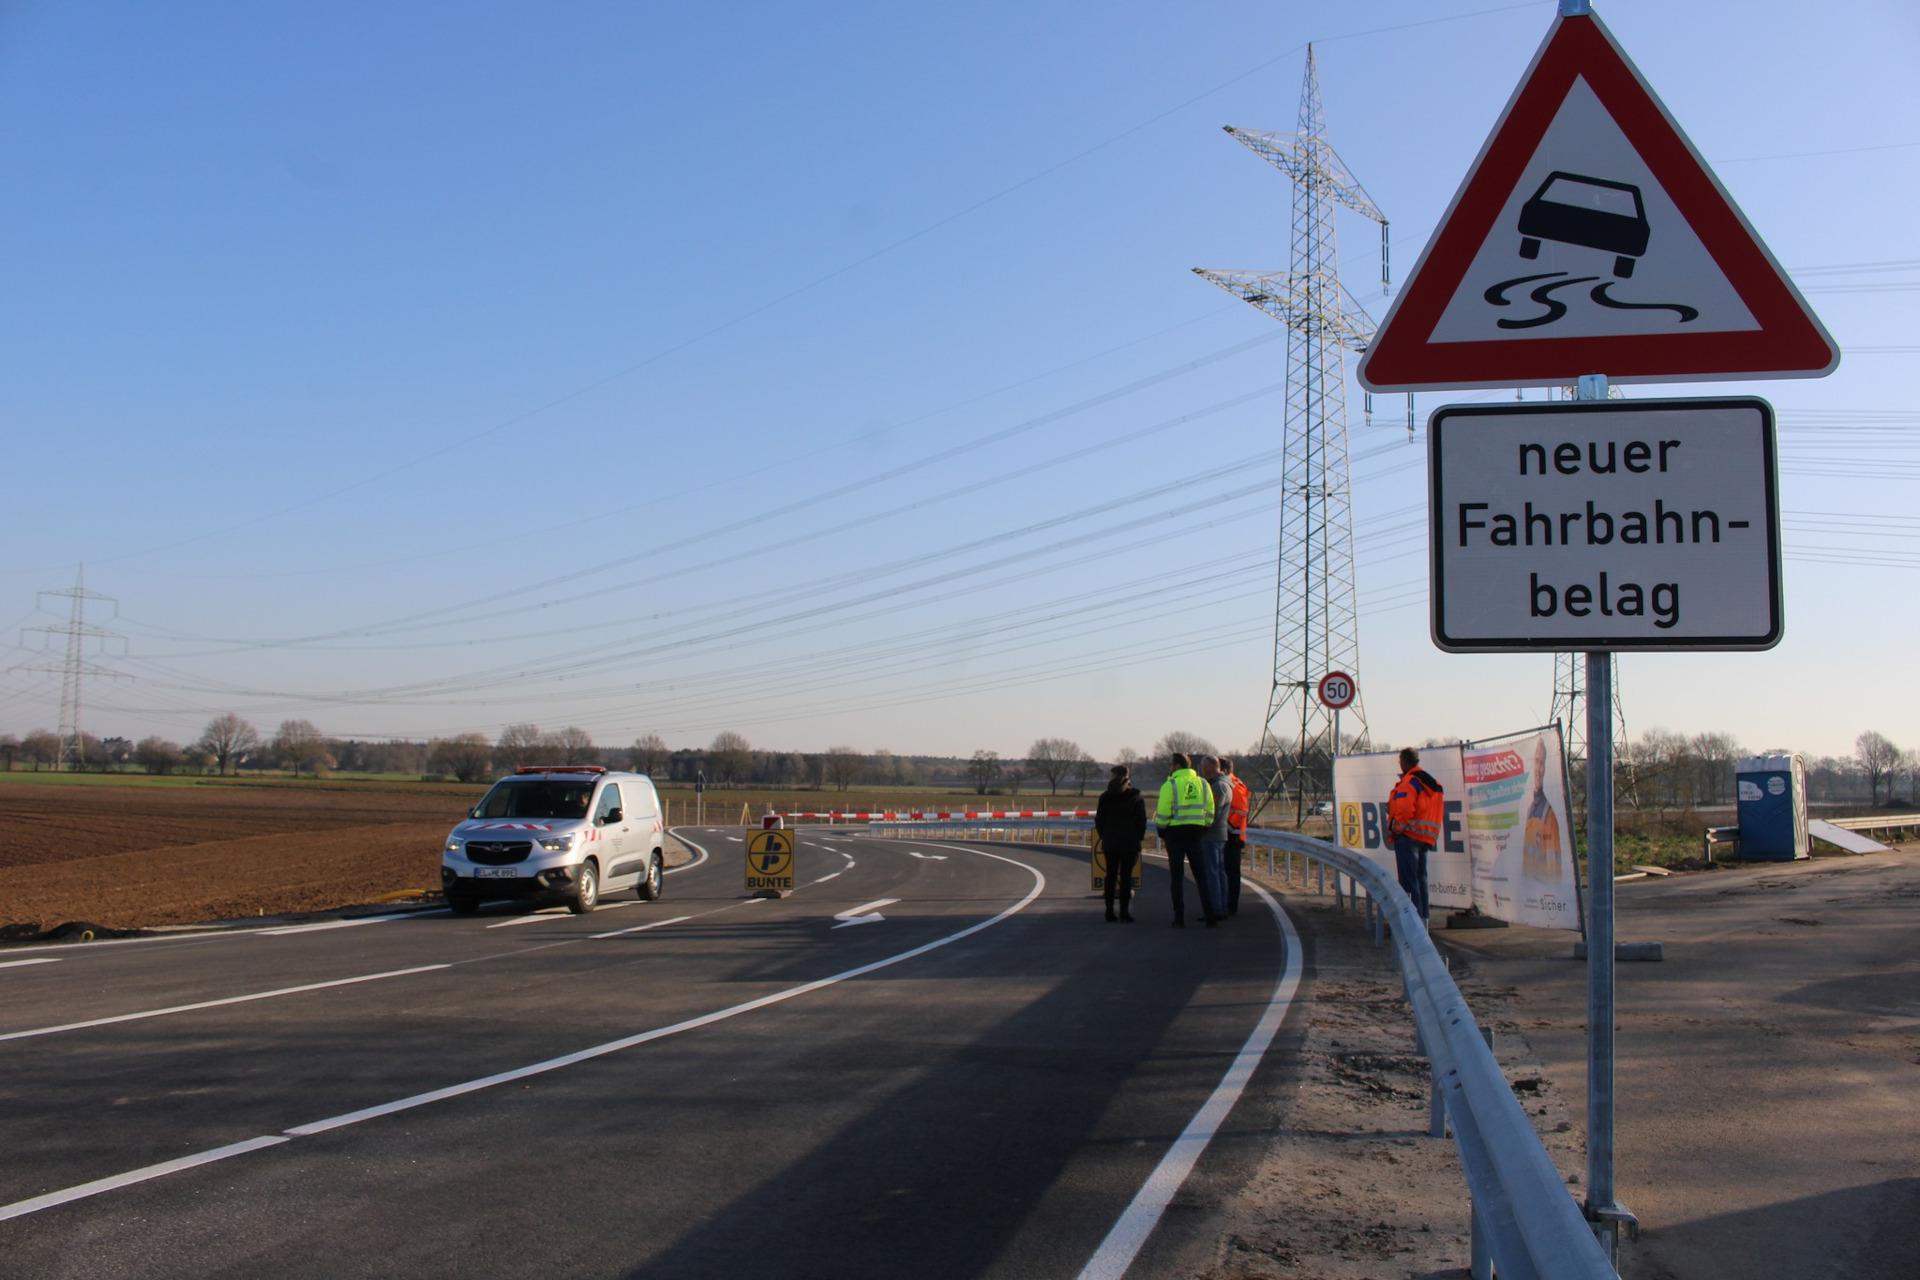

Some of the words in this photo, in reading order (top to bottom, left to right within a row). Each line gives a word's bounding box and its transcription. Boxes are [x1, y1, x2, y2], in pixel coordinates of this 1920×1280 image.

[1519, 439, 1681, 476] neuer
[1458, 499, 1750, 547] Fahrbahn-
[1530, 571, 1679, 629] belag
[1327, 682, 1347, 699] 50
[1361, 801, 1464, 852] BUE
[747, 876, 792, 888] BUNTE
